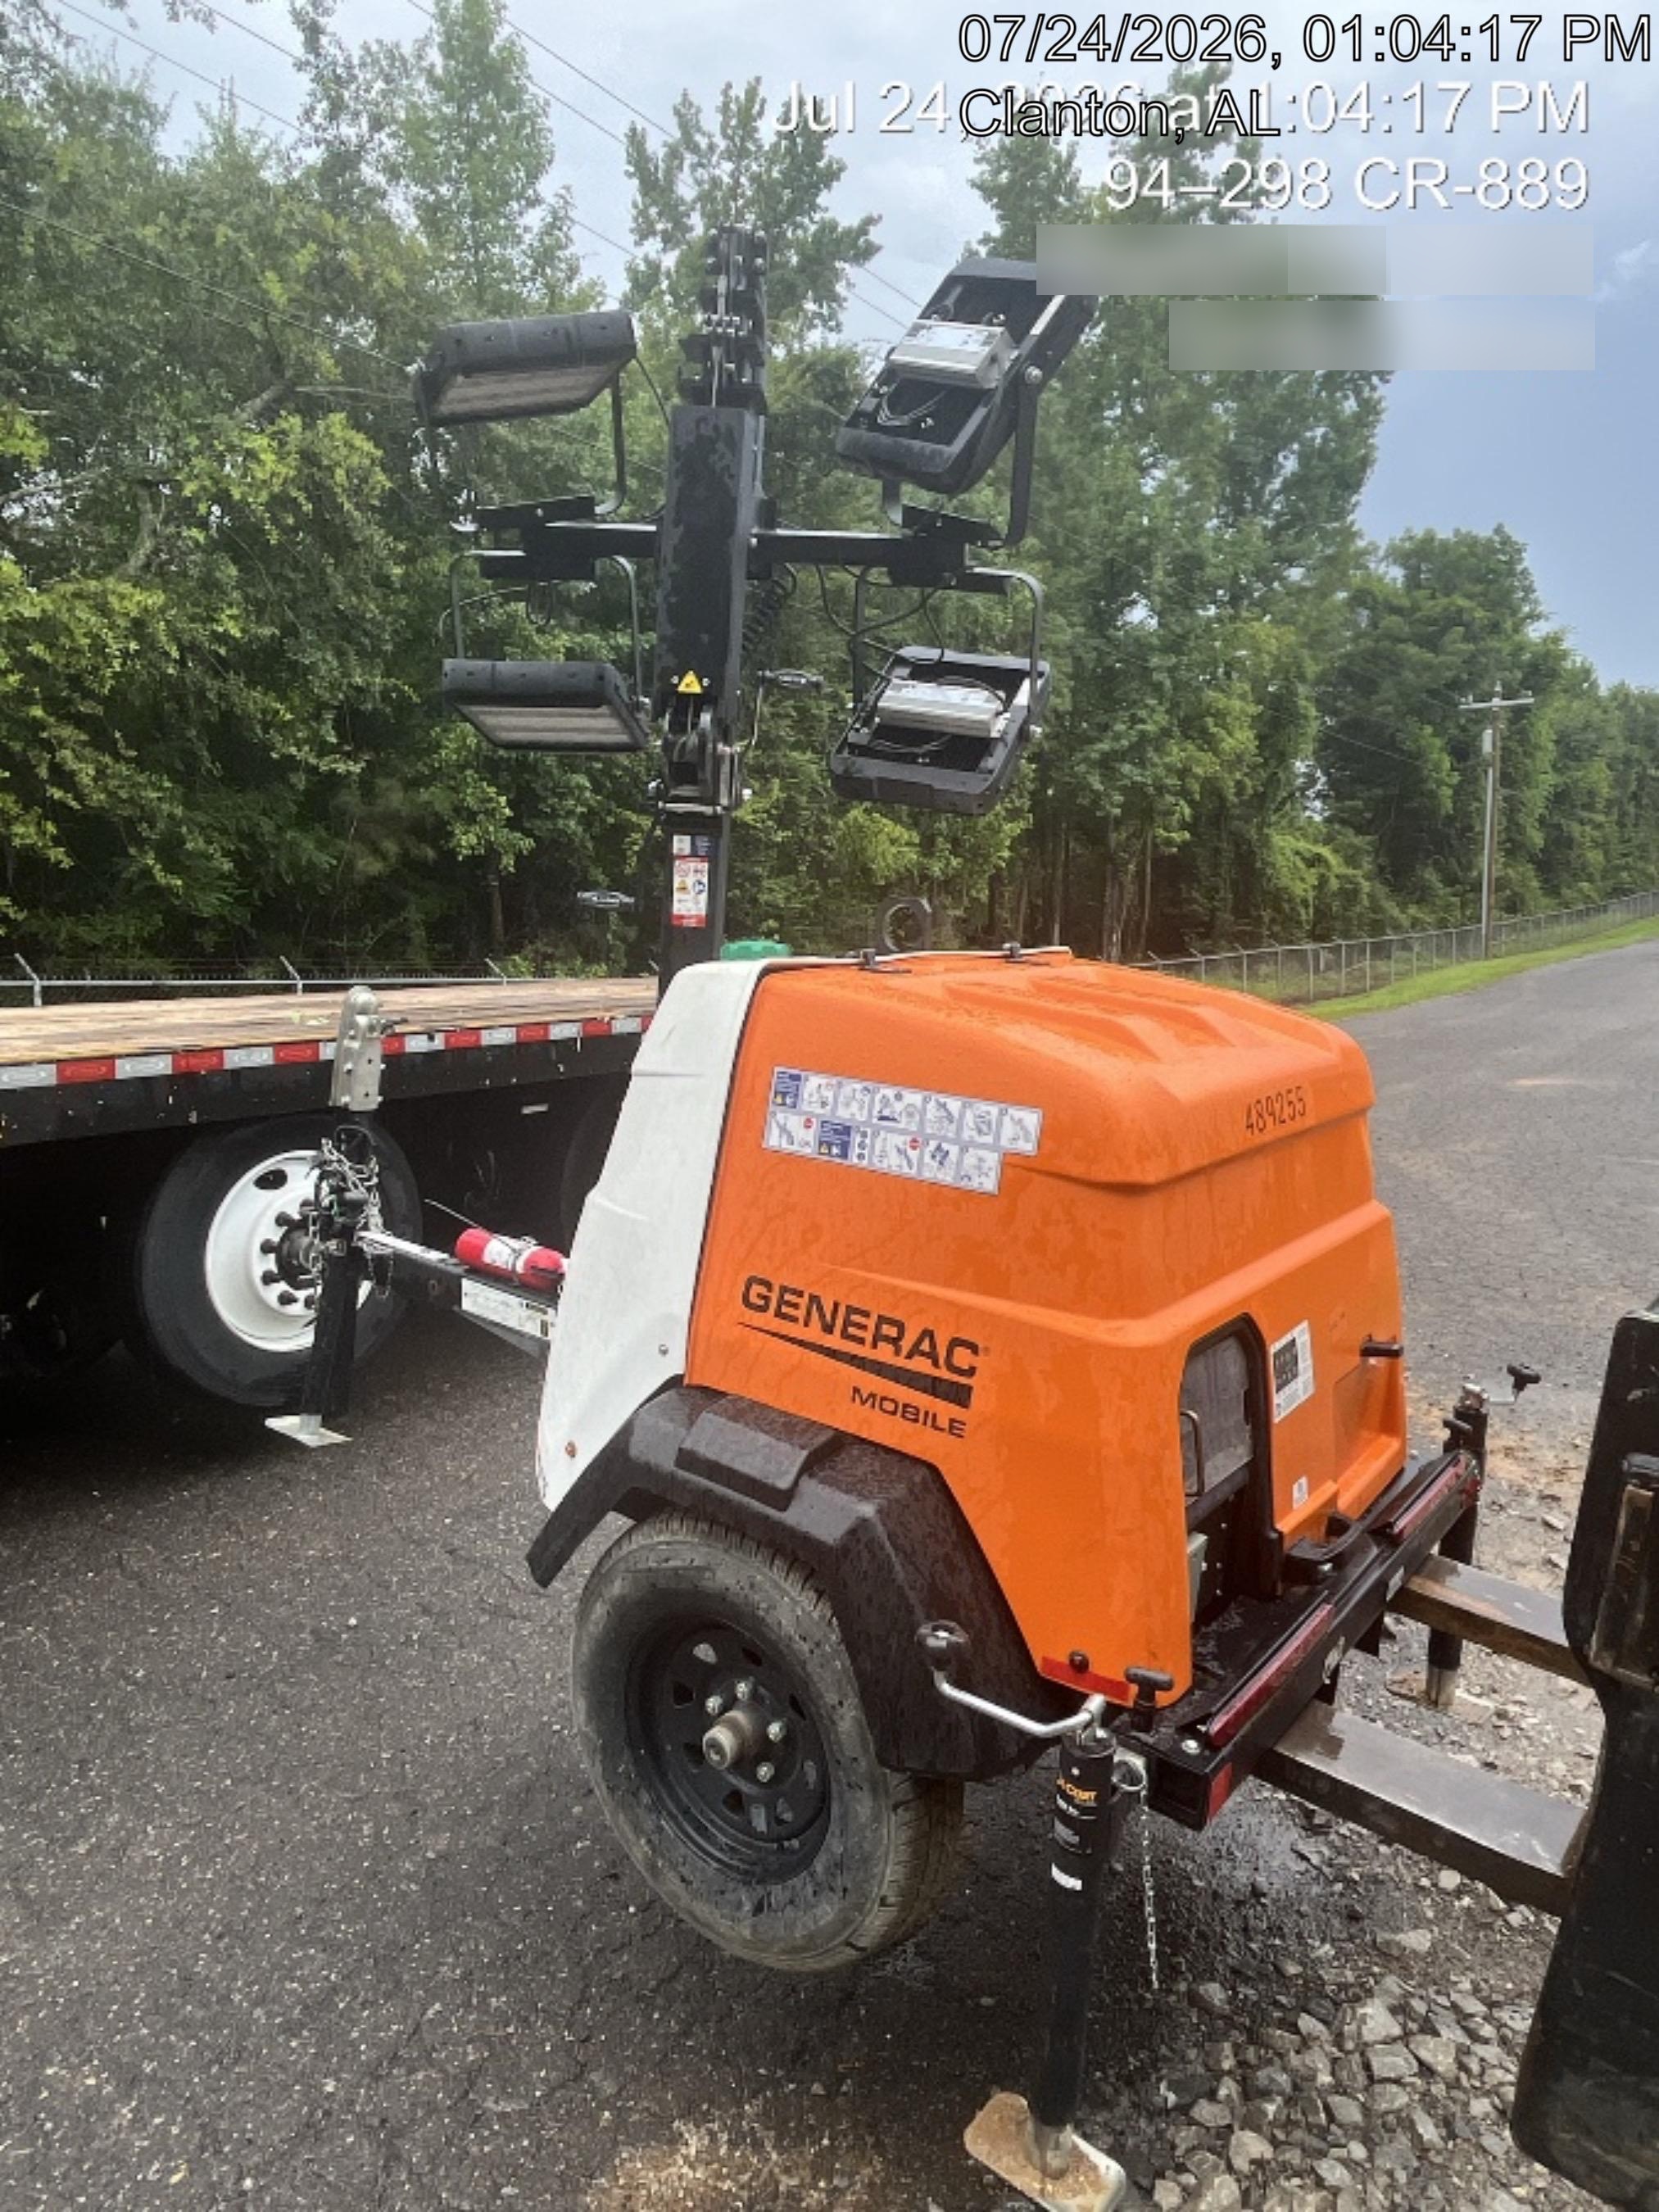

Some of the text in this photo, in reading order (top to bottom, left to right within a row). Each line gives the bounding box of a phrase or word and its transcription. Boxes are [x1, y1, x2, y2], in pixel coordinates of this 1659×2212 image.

[1244, 1086, 1307, 1136] 489255
[741, 1275, 980, 1379] GENERAC
[851, 1385, 968, 1439] MOBILE
